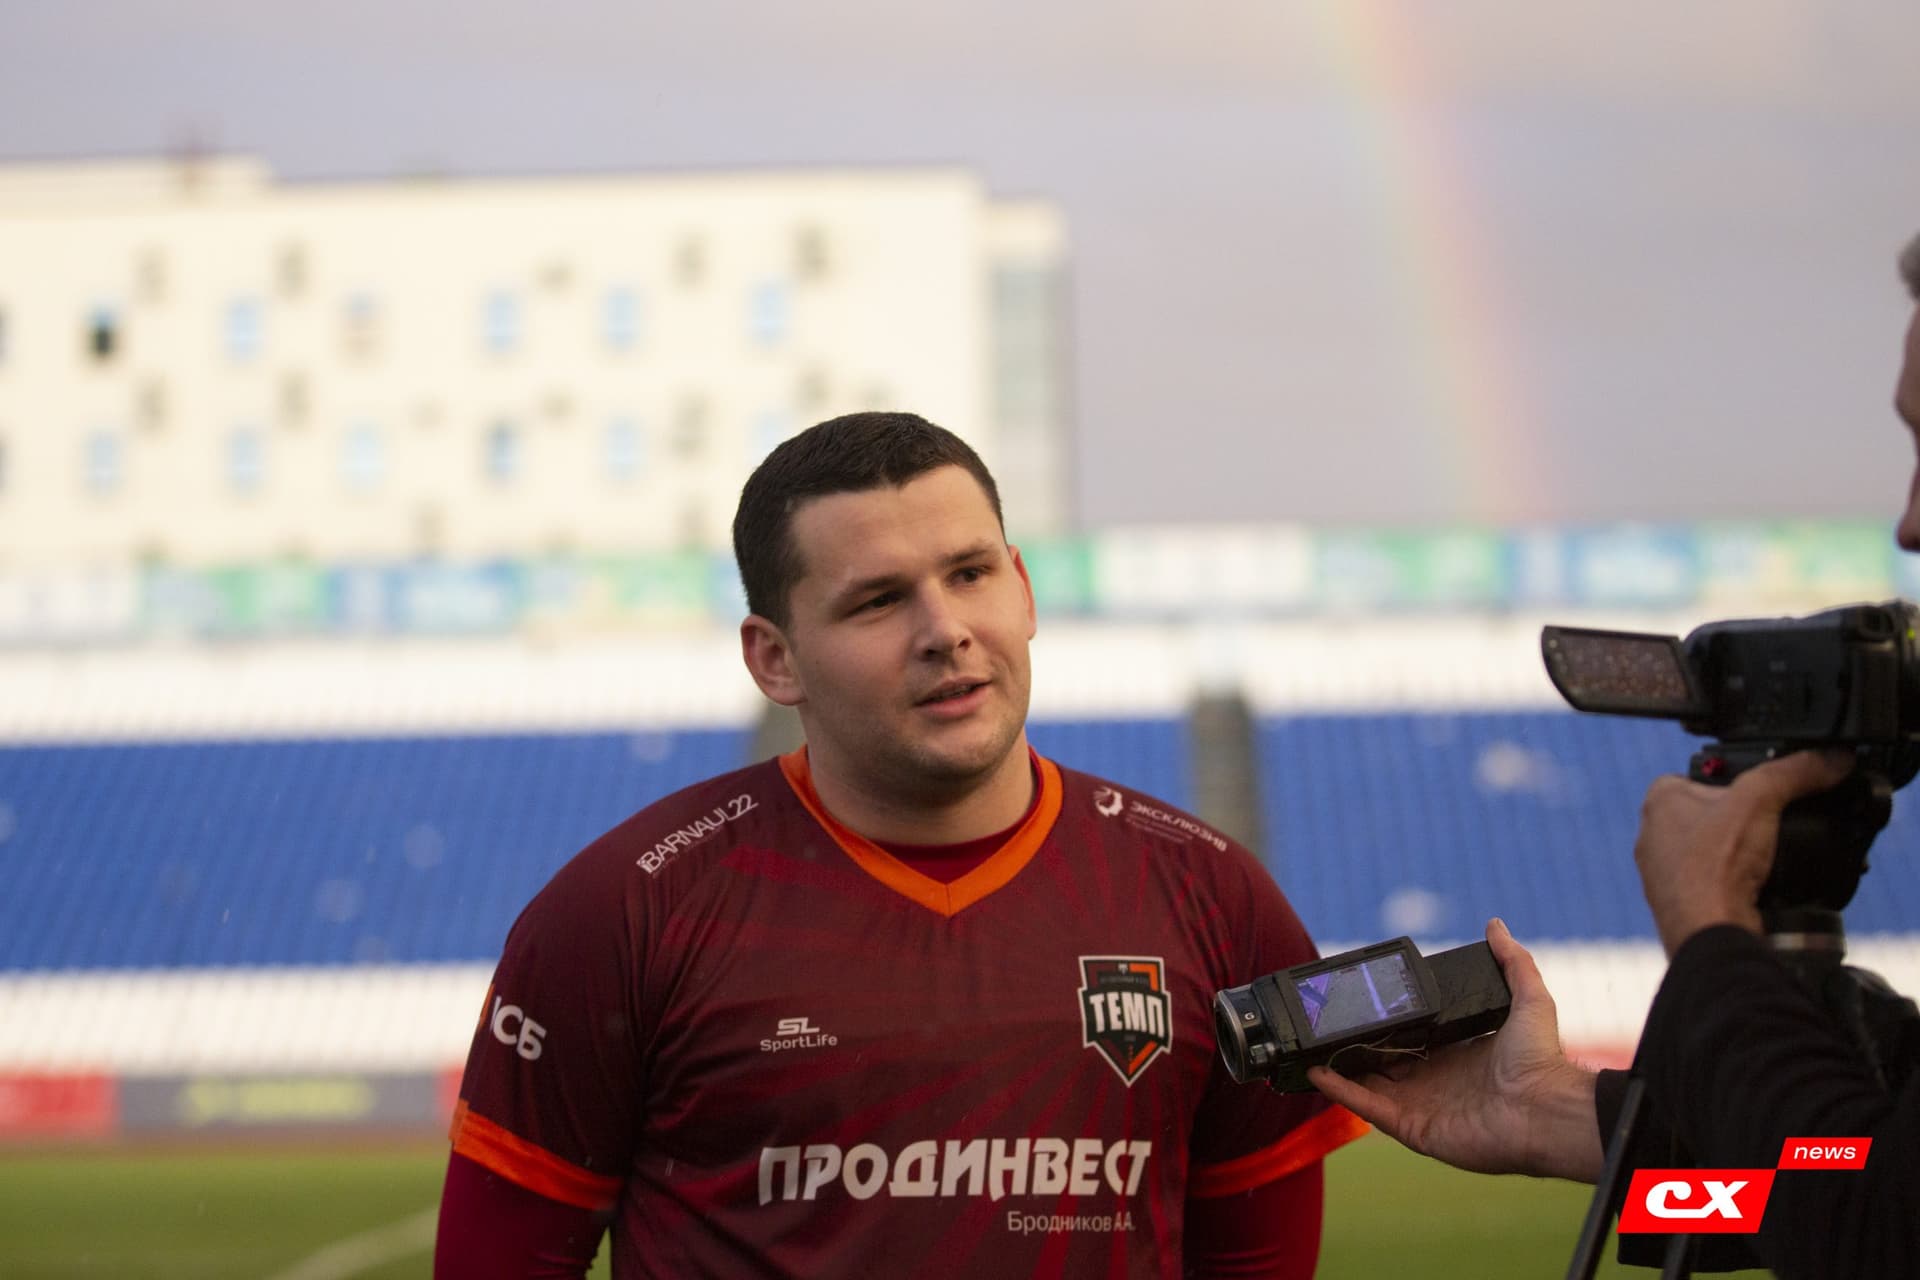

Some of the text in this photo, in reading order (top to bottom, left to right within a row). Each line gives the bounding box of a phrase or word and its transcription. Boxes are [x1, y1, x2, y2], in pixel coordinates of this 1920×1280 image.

[490, 996, 547, 1061] СБ
[1089, 991, 1165, 1038] ТЕМП
[760, 1034, 838, 1053] SportLife
[758, 1138, 1152, 1206] ПРОДИНВЕСТ
[1007, 1210, 1112, 1237] Бродников
